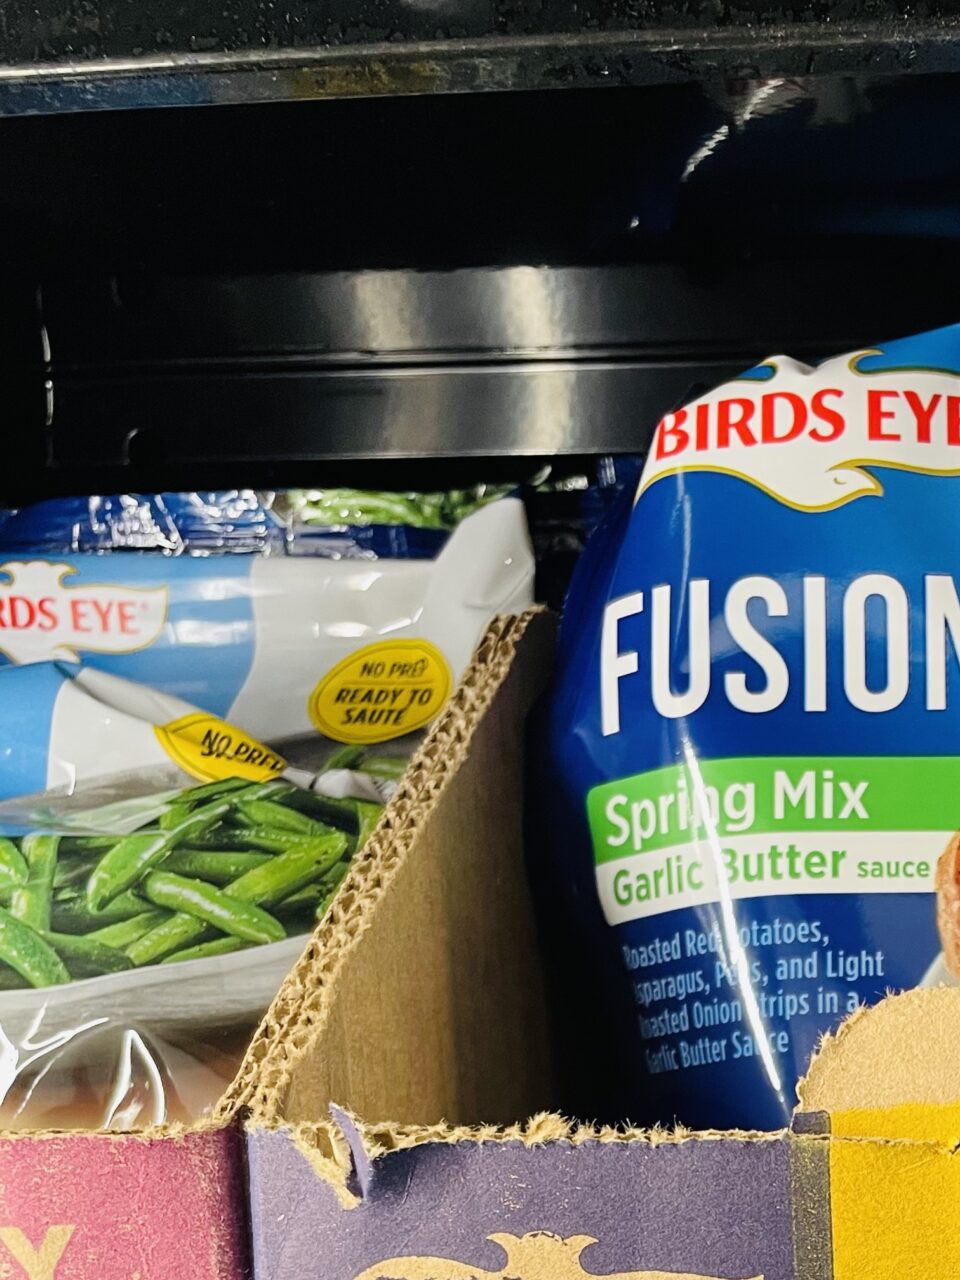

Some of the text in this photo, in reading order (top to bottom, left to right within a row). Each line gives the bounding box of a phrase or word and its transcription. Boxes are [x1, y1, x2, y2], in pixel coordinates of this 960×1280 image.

[655, 388, 846, 462] BIRDS
[0, 596, 140, 635] DS EYE
[360, 661, 385, 678] NO
[334, 687, 432, 706] READY TO
[201, 729, 232, 758] NO
[605, 769, 870, 851] Spring Mix
[613, 843, 930, 906] Garlic Butter sauce
[623, 918, 830, 971] Roasted Red otatoes,
[633, 950, 885, 1007] sparagus, Pes, and Light
[693, 997, 742, 1029] Onion
[750, 989, 810, 1021] trips
[817, 987, 839, 1014] in
[846, 991, 860, 1012] a
[680, 1036, 727, 1068] Butter
[732, 1030, 790, 1059] Sace
